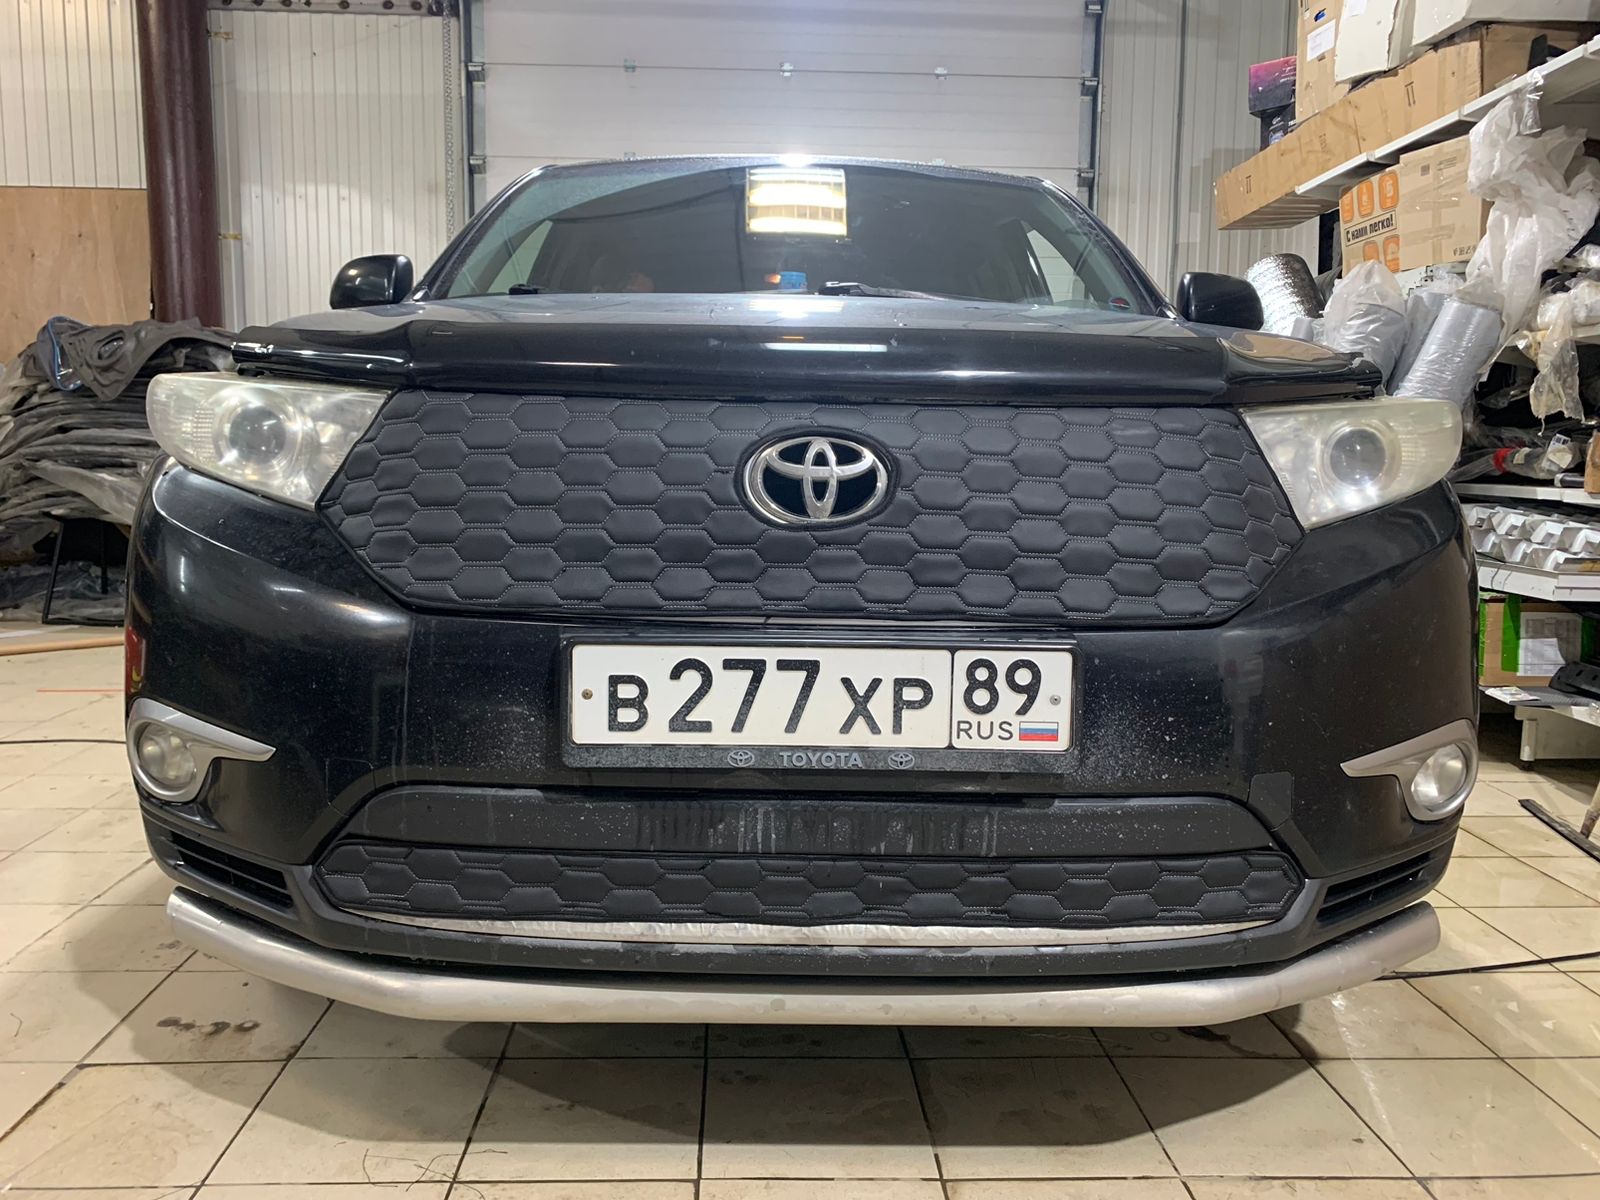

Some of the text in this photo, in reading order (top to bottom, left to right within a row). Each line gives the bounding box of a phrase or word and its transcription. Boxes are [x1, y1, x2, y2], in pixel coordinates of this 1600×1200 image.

[1369, 213, 1394, 234] легко!
[963, 658, 1042, 716] 89
[956, 720, 1014, 741] RUS
[779, 751, 864, 768] TOYOTA
